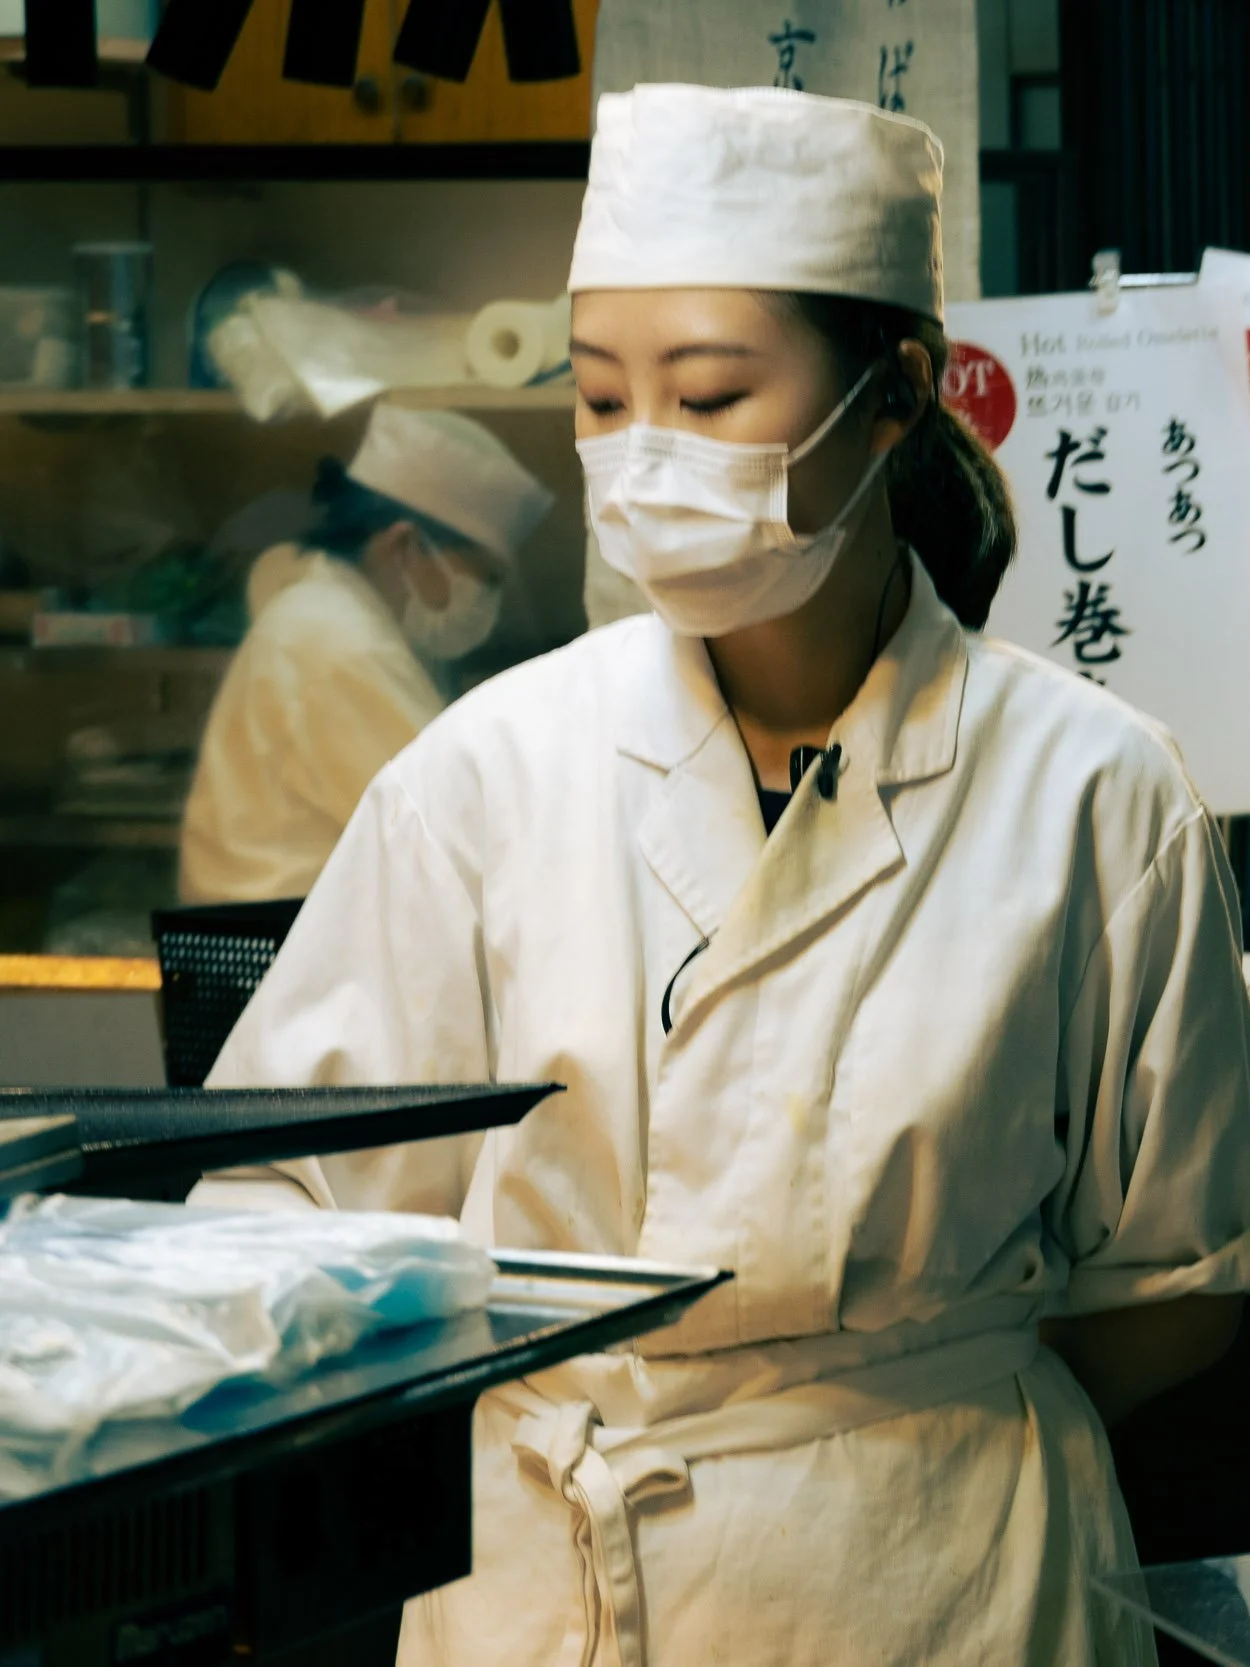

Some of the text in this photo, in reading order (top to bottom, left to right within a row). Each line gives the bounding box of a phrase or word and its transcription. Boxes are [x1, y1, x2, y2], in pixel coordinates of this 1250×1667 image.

[940, 359, 996, 397] OT
[1020, 331, 1067, 358] Hot
[1161, 416, 1206, 556] あつあつ
[1044, 423, 1135, 686] だし巻
